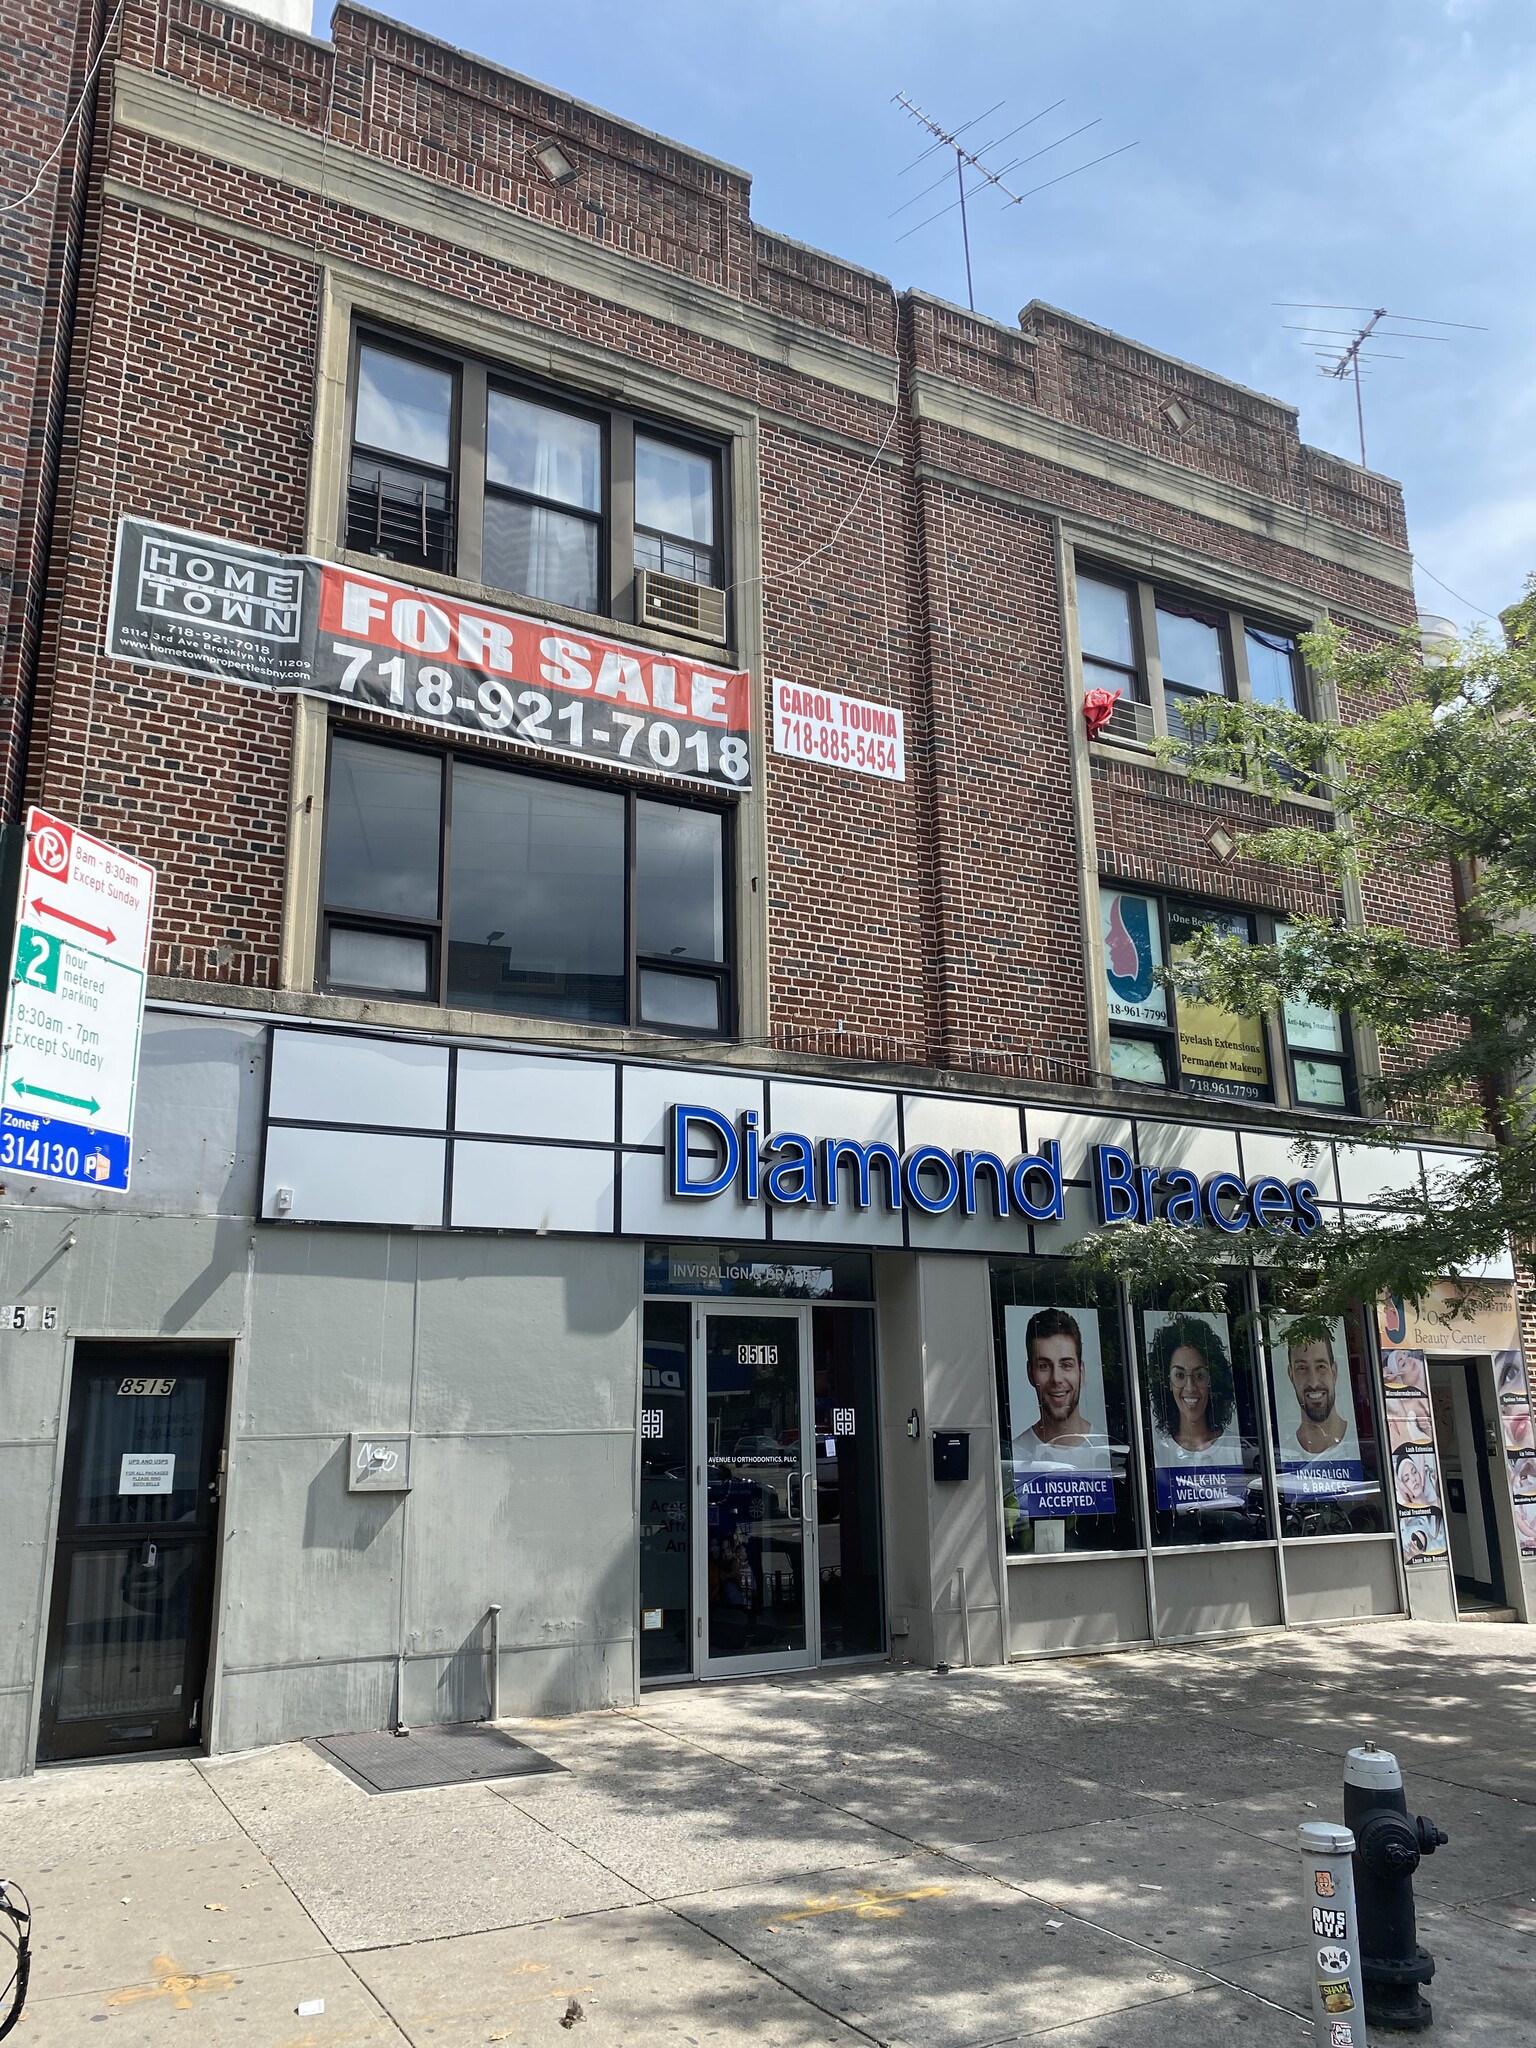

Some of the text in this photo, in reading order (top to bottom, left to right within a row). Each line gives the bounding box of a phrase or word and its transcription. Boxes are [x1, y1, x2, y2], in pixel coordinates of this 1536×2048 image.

[149, 548, 293, 600] HOME
[150, 574, 293, 610] PROPERTIES
[148, 582, 292, 634] TOWN
[121, 626, 311, 669] 8114 3rd Ave Brooklyn NY 11209
[167, 623, 270, 655] 718-921-7018
[119, 637, 311, 681] www.hometownpropertiesbny.com
[341, 580, 728, 723] FOR SALE
[332, 642, 750, 781] 718-921-7018
[779, 685, 897, 739] CAROL TOUMA
[782, 716, 896, 774] 718-885-5454
[76, 846, 96, 867] 8am
[105, 861, 139, 888] 8:30am
[73, 867, 140, 911] Except Sunday
[1221, 923, 1249, 936] Center
[25, 935, 49, 984] 2
[65, 951, 88, 971] hour
[63, 970, 105, 994] metered
[61, 986, 99, 1012] parking
[1107, 1004, 1166, 1020] 18-961-7799
[18, 1004, 63, 1034] 8:30am
[76, 1023, 100, 1046] 7pm
[15, 1027, 104, 1072] Except Sunday
[1180, 1033, 1260, 1053] Eyelash Extensions
[1181, 1054, 1262, 1076] Permanent Makeup
[1189, 1079, 1259, 1098] 718.961.7799
[3, 1112, 40, 1132] Zone#
[1, 1133, 79, 1177] 314130
[668, 1103, 1323, 1236] Diamond Braces
[673, 1264, 749, 1280] INVISALIGN
[1414, 1329, 1486, 1349] Beauty Center
[739, 1346, 777, 1364] 8515
[120, 1379, 174, 1394] 8515
[1176, 1474, 1226, 1487] WALK-INS
[1296, 1468, 1350, 1480] INVISALIGN
[1022, 1481, 1107, 1494] ALL INSURANCE
[1176, 1488, 1229, 1500] WELCOME
[1303, 1481, 1348, 1493] & BRACES
[1039, 1495, 1096, 1508] ACCEPTED.
[1314, 1920, 1344, 1938] NYC
[1323, 1984, 1348, 1995] SHAM
